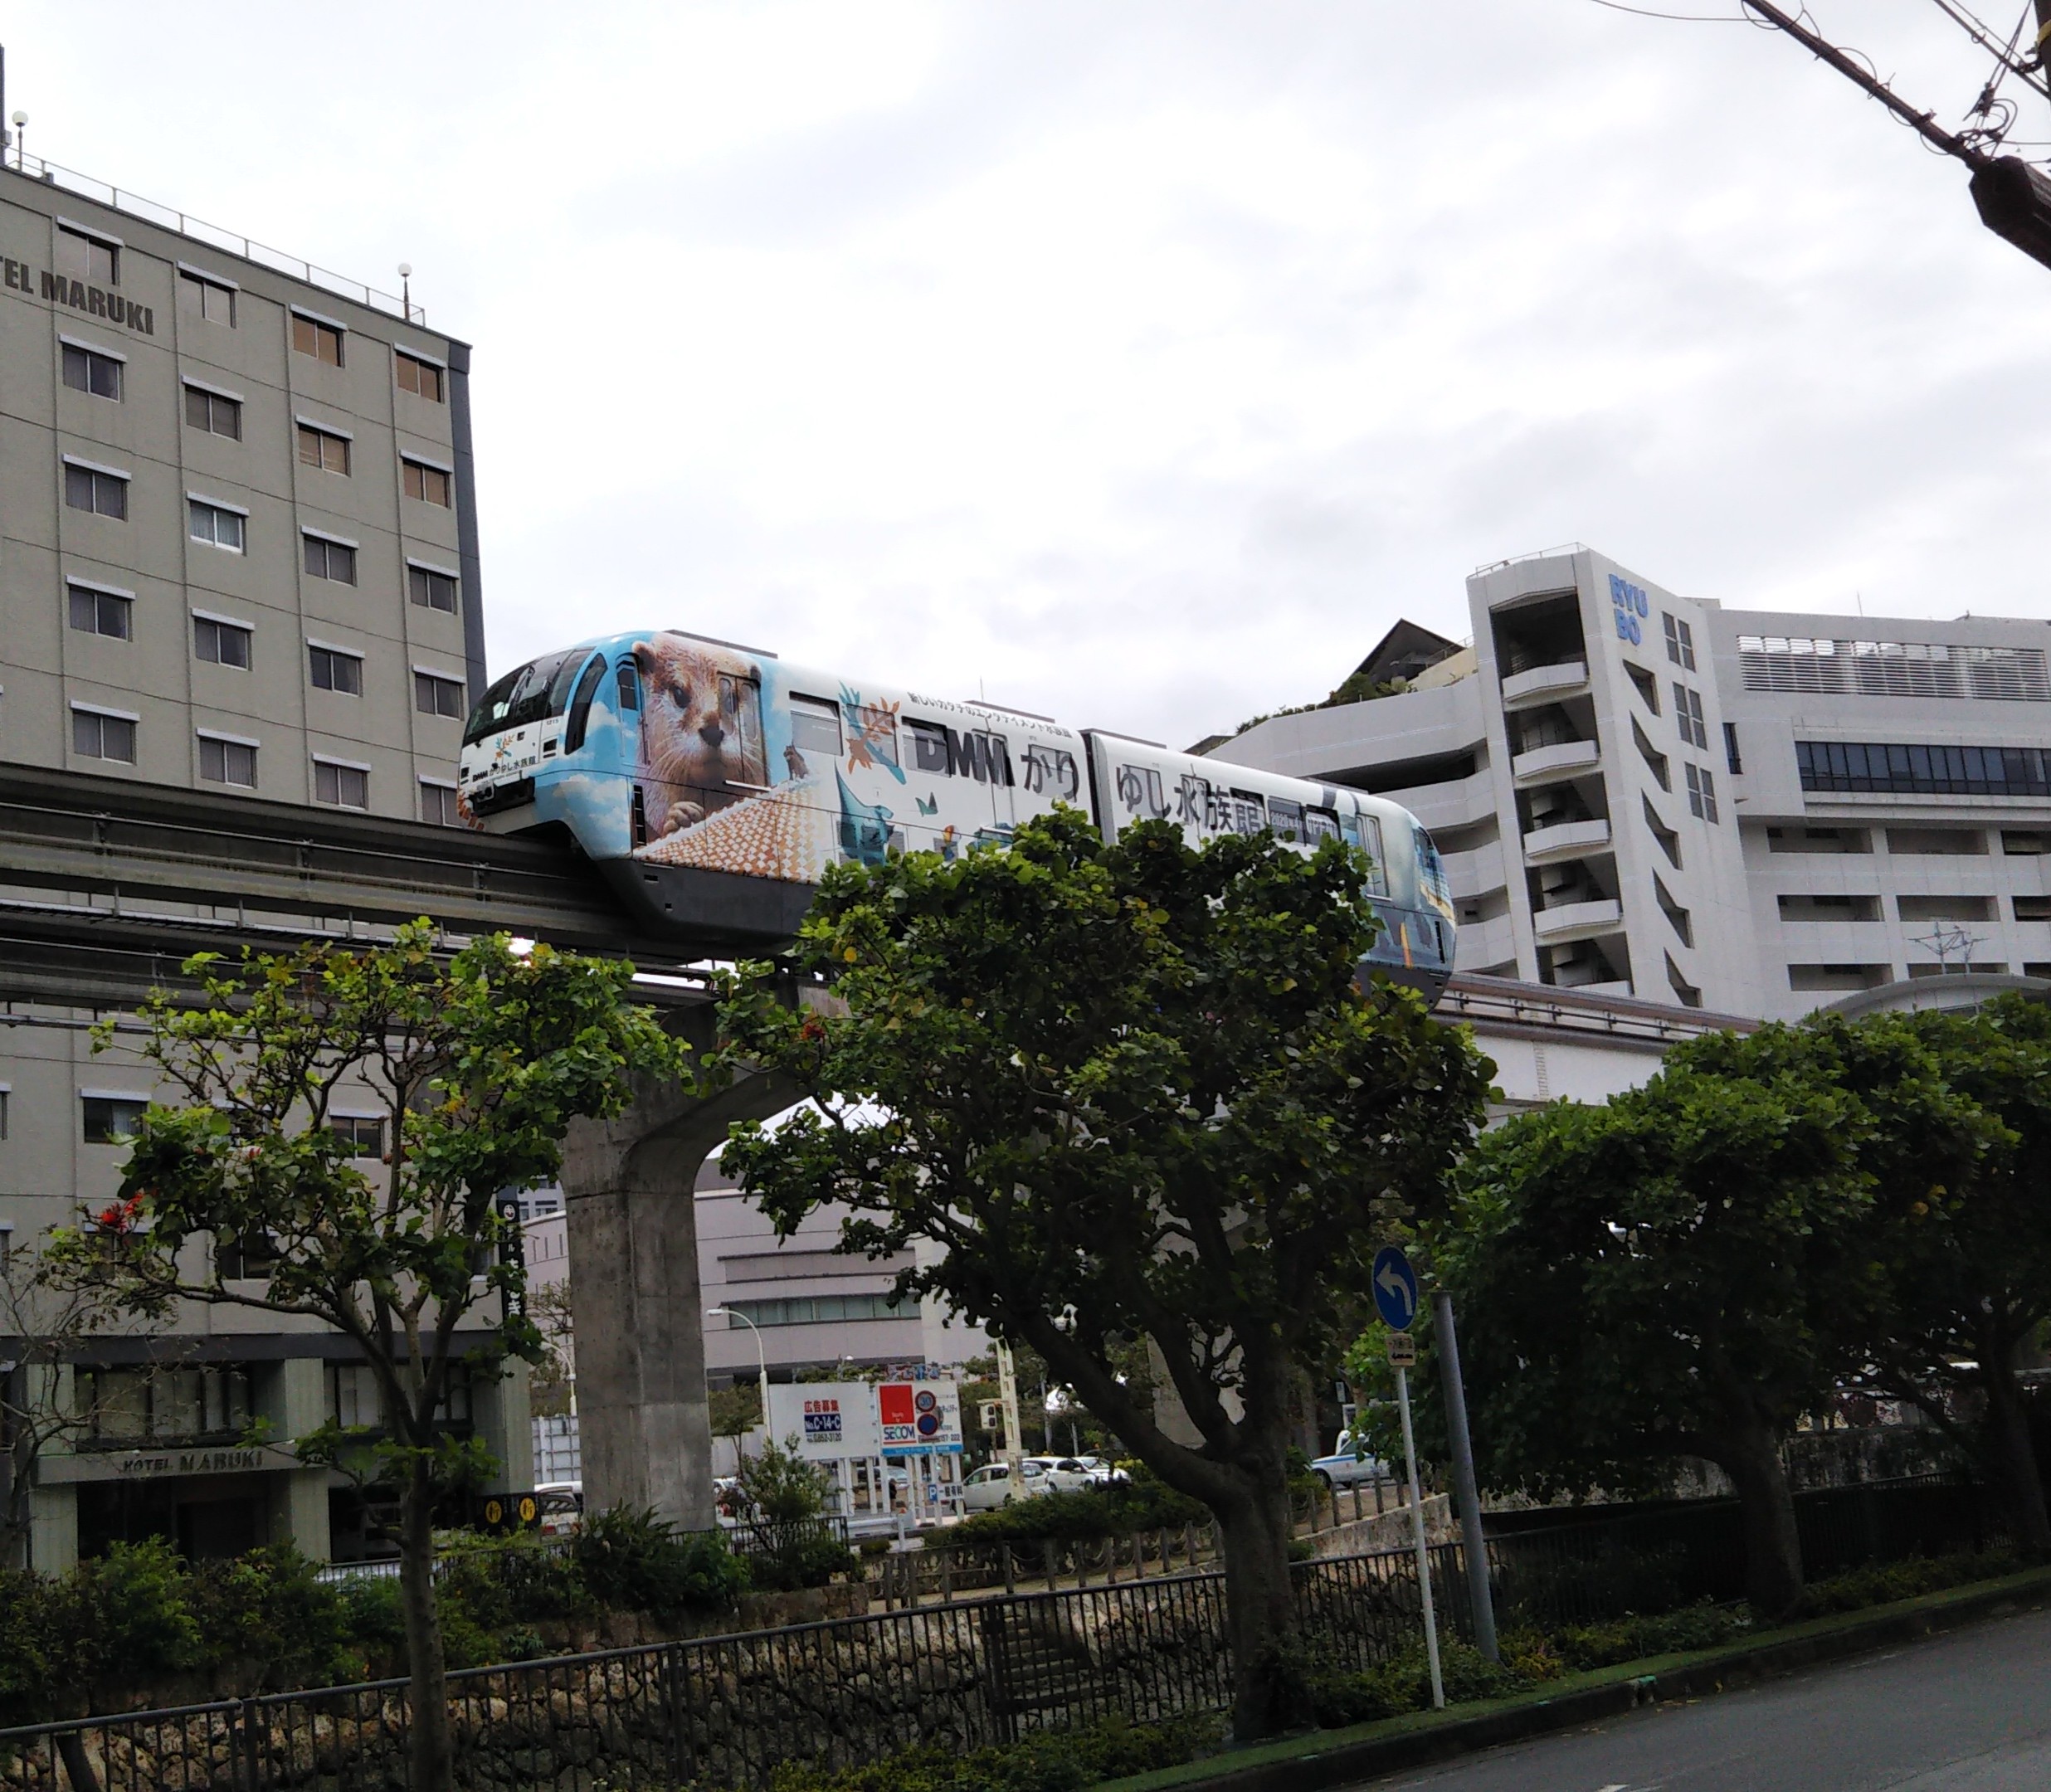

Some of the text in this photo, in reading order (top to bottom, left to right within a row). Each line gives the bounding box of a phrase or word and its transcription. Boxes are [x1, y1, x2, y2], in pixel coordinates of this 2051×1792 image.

[41, 270, 153, 336] MARUKI
[1608, 573, 1649, 618] RYU
[1613, 608, 1641, 645] BO
[910, 723, 1016, 787] DMM
[472, 770, 488, 782] DMM
[804, 1399, 840, 1414] 広告募集
[884, 1426, 915, 1440] SECOM
[123, 1450, 264, 1473] HOTEL MARUKI
[929, 1486, 937, 1499] P
